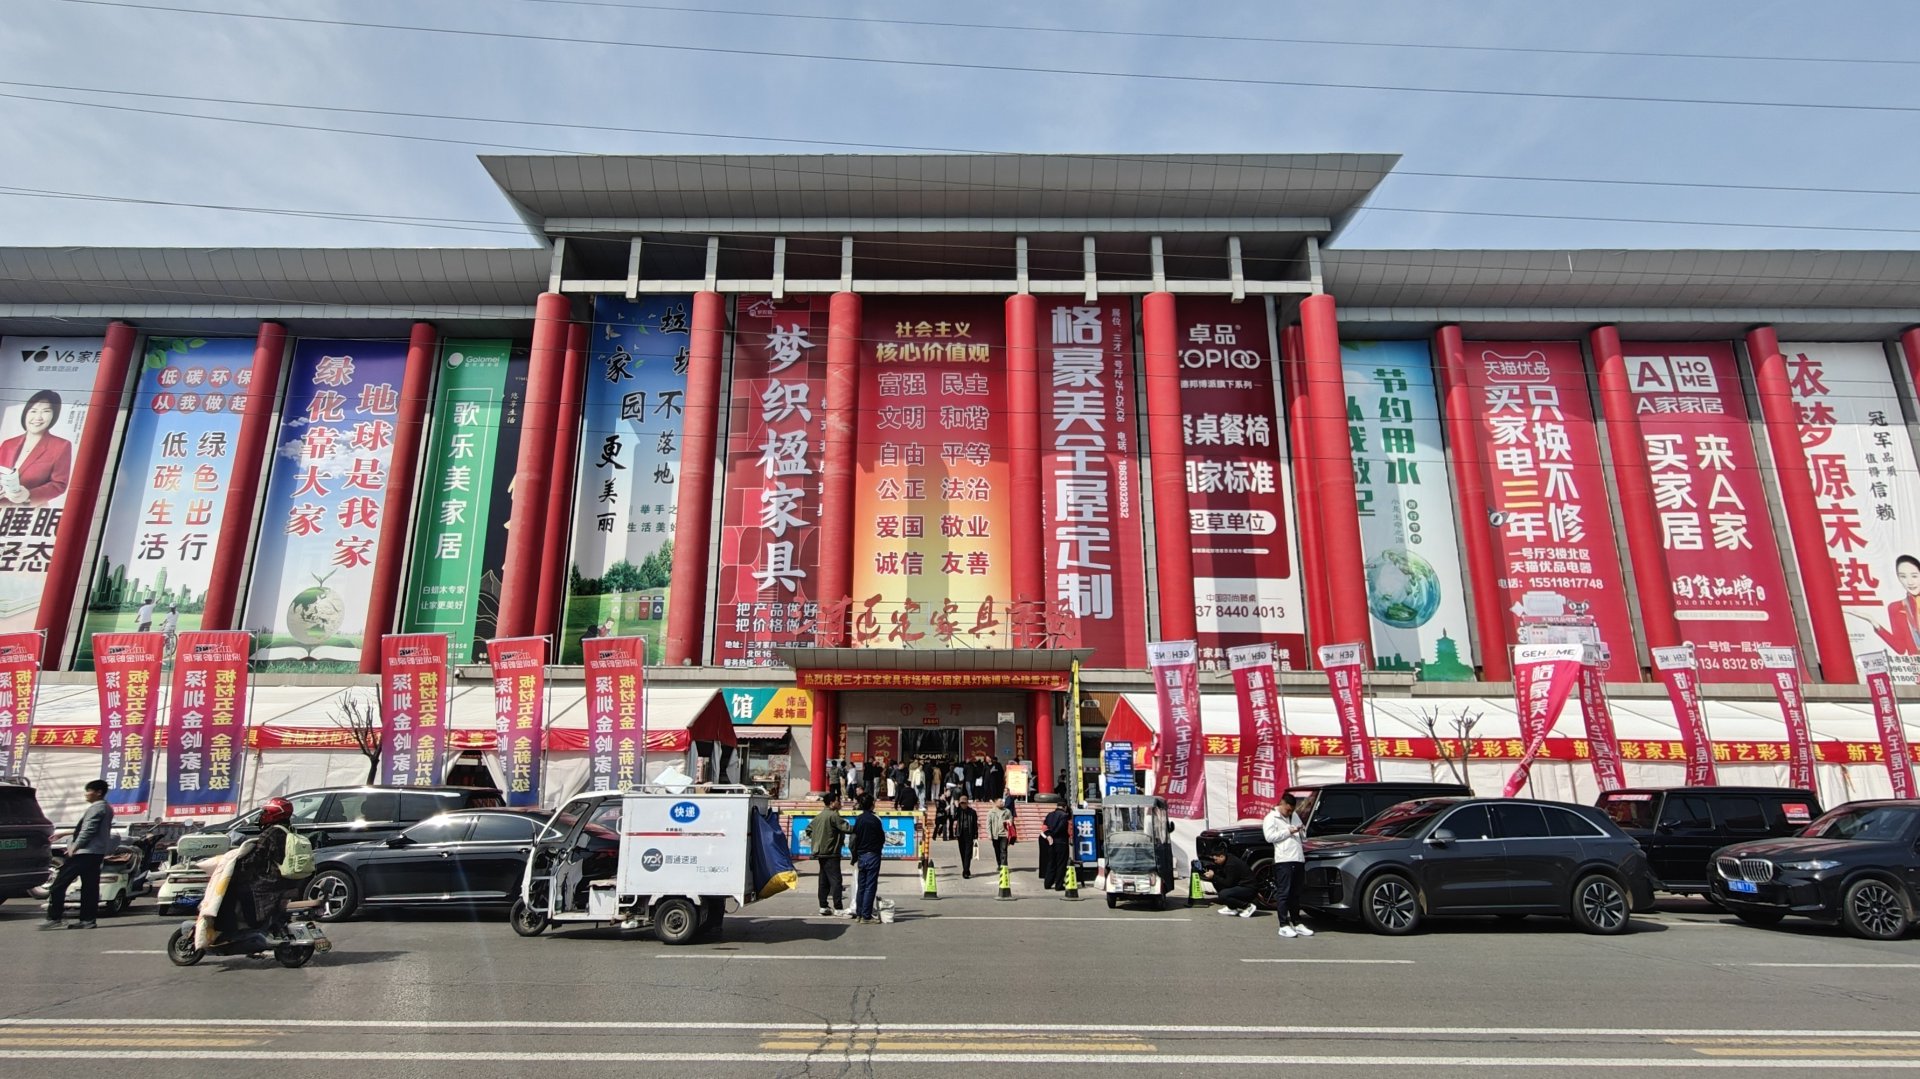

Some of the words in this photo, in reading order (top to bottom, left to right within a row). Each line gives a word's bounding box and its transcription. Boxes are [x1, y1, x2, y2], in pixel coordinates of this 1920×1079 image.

[895, 321, 972, 339] 社会主义
[1189, 323, 1236, 345] 卓品
[875, 342, 990, 363] 核心价值观
[160, 368, 252, 386] 低碳环保
[1484, 360, 1551, 376] 天猫优品
[1637, 361, 1666, 387] A
[876, 372, 926, 396] 富强
[940, 372, 990, 396] 民主
[153, 393, 247, 411] 从我做起
[1636, 397, 1725, 415] A家家居
[876, 406, 926, 430] 文明
[940, 406, 990, 430] 和谐
[1373, 368, 1422, 485] 节约用水
[1868, 410, 1893, 449] 冠军
[284, 355, 353, 537] 绿化靠大家
[876, 442, 926, 466] 自由
[940, 442, 990, 466] 平等
[751, 324, 817, 594] 梦织楹家具
[1050, 306, 1114, 620] 格豪美全屋定制
[1483, 385, 1547, 542] 买家电三年
[1526, 385, 1586, 543] 只换不修
[332, 383, 398, 570] 地球是我家
[435, 401, 480, 560] 歌乐美家居
[137, 431, 189, 560] 低碳生活
[179, 431, 227, 561] 绿色出行
[876, 478, 926, 501] 公正
[940, 478, 990, 501] 法治
[1643, 433, 1704, 550] 买家居
[1694, 433, 1753, 550] 来A家
[1869, 481, 1897, 522] 信赖
[876, 515, 926, 539] 爱国
[940, 515, 990, 539] 敬业
[1190, 512, 1266, 532] 起草单位
[876, 551, 926, 576] 诚信
[940, 551, 990, 576] 友善
[1508, 547, 1591, 561] 一号厅3楼北区
[1510, 560, 1593, 575] 天猫优品电器
[1216, 605, 1249, 618] 8440
[1252, 606, 1285, 619] 4013
[1700, 658, 1720, 670] 134
[1722, 658, 1749, 670] 8312
[731, 693, 755, 719] 馆
[773, 708, 808, 719] 装饰画
[786, 696, 808, 707] 饰品
[1573, 740, 1687, 761] 新彩家具
[674, 806, 696, 818] 快递
[1076, 820, 1094, 855] 进口
[665, 855, 698, 865] 圆通速递
